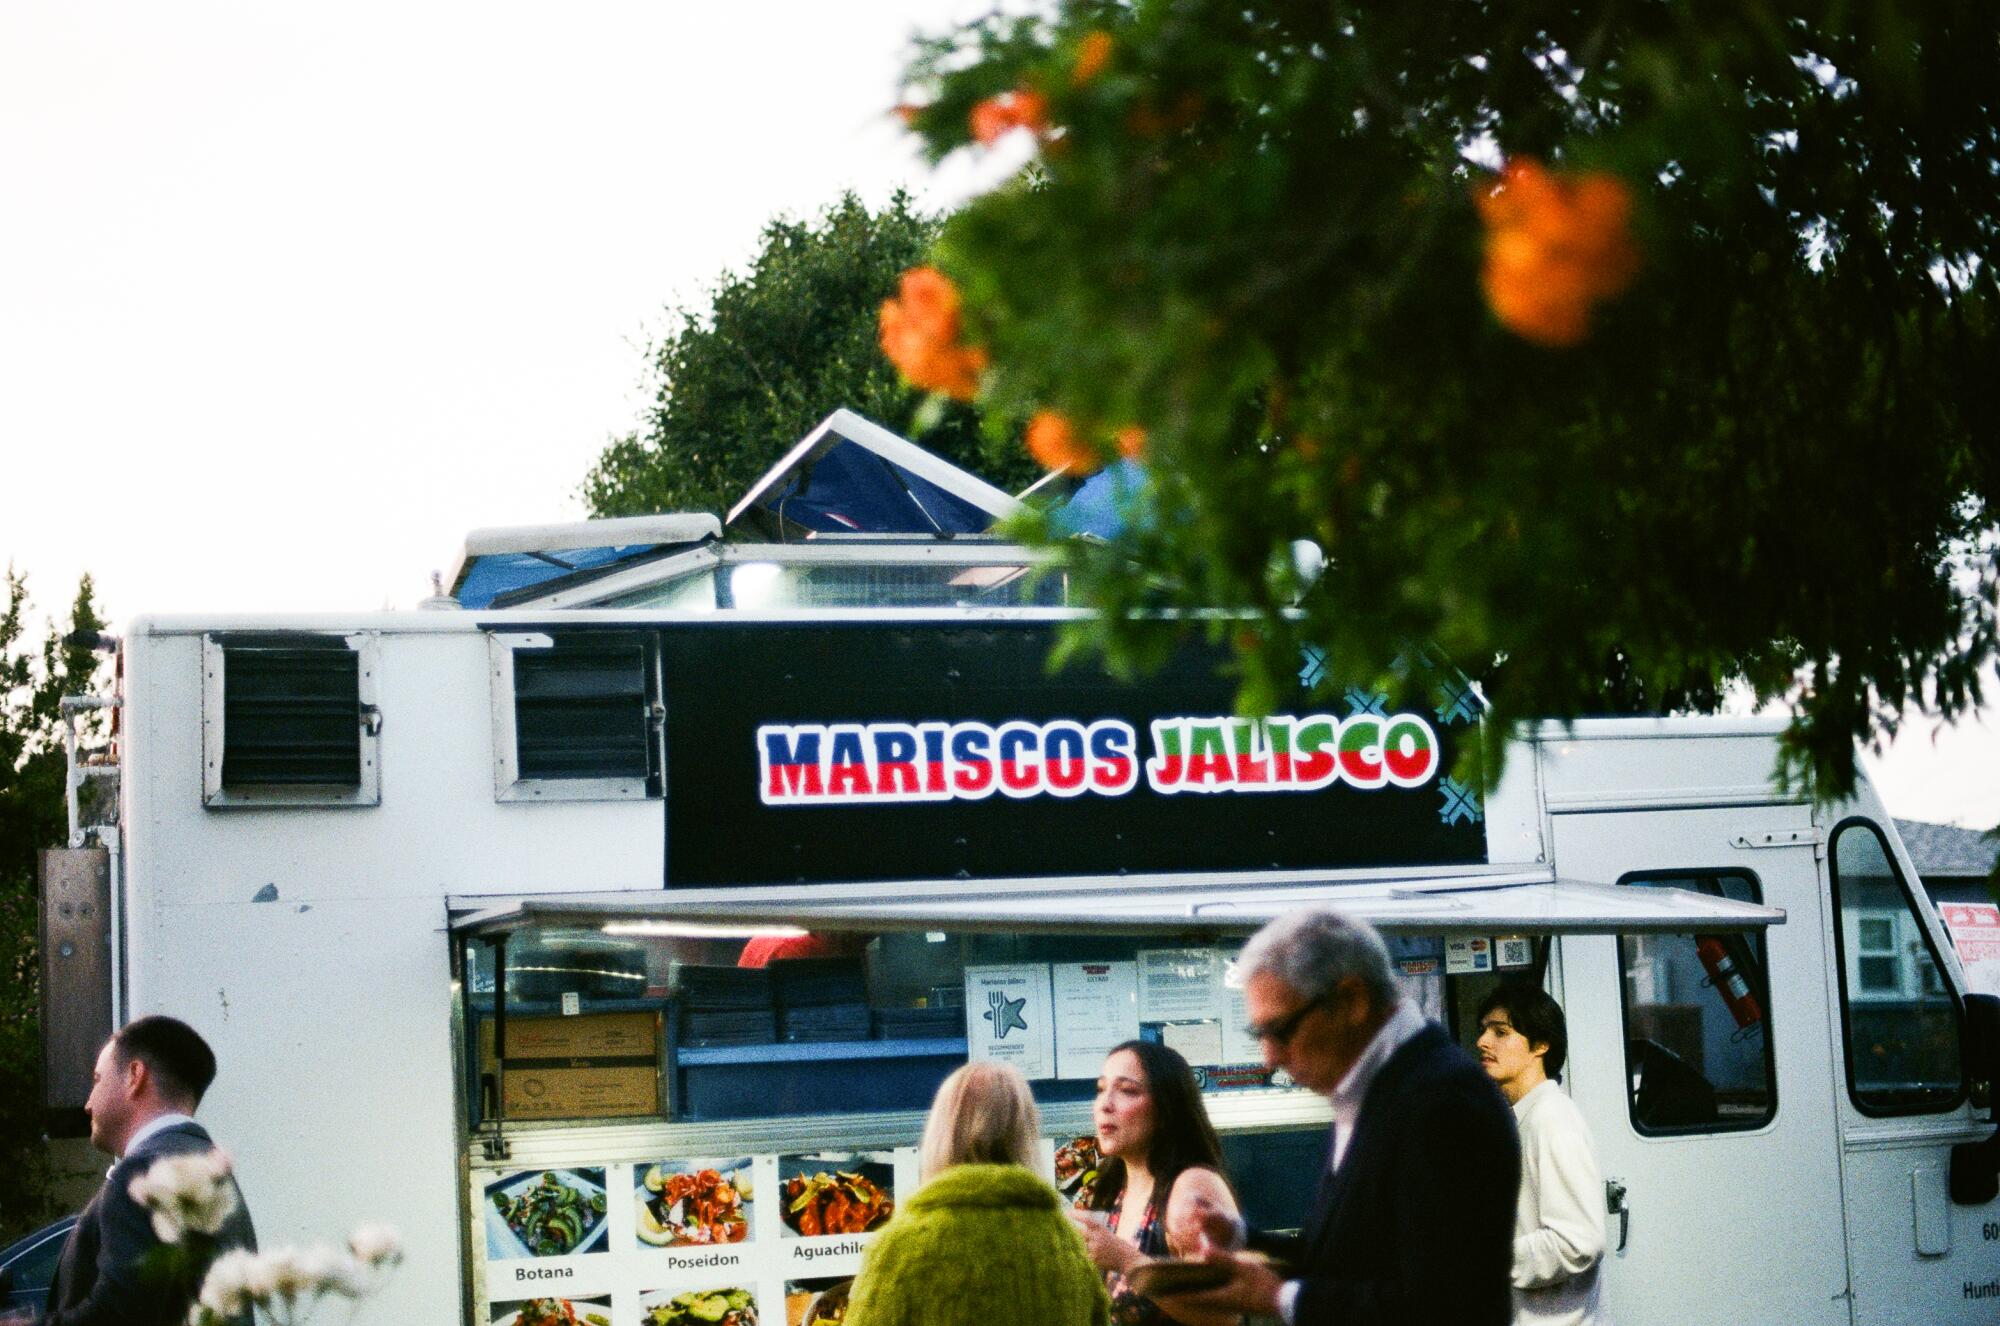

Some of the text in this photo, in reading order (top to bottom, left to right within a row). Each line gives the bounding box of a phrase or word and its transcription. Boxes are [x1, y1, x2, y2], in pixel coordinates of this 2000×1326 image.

[760, 716, 1437, 803] MARISCOS JALISCO
[1983, 1223, 2000, 1240] 60
[668, 1253, 740, 1270] Poseidon
[515, 1265, 574, 1281] Botana
